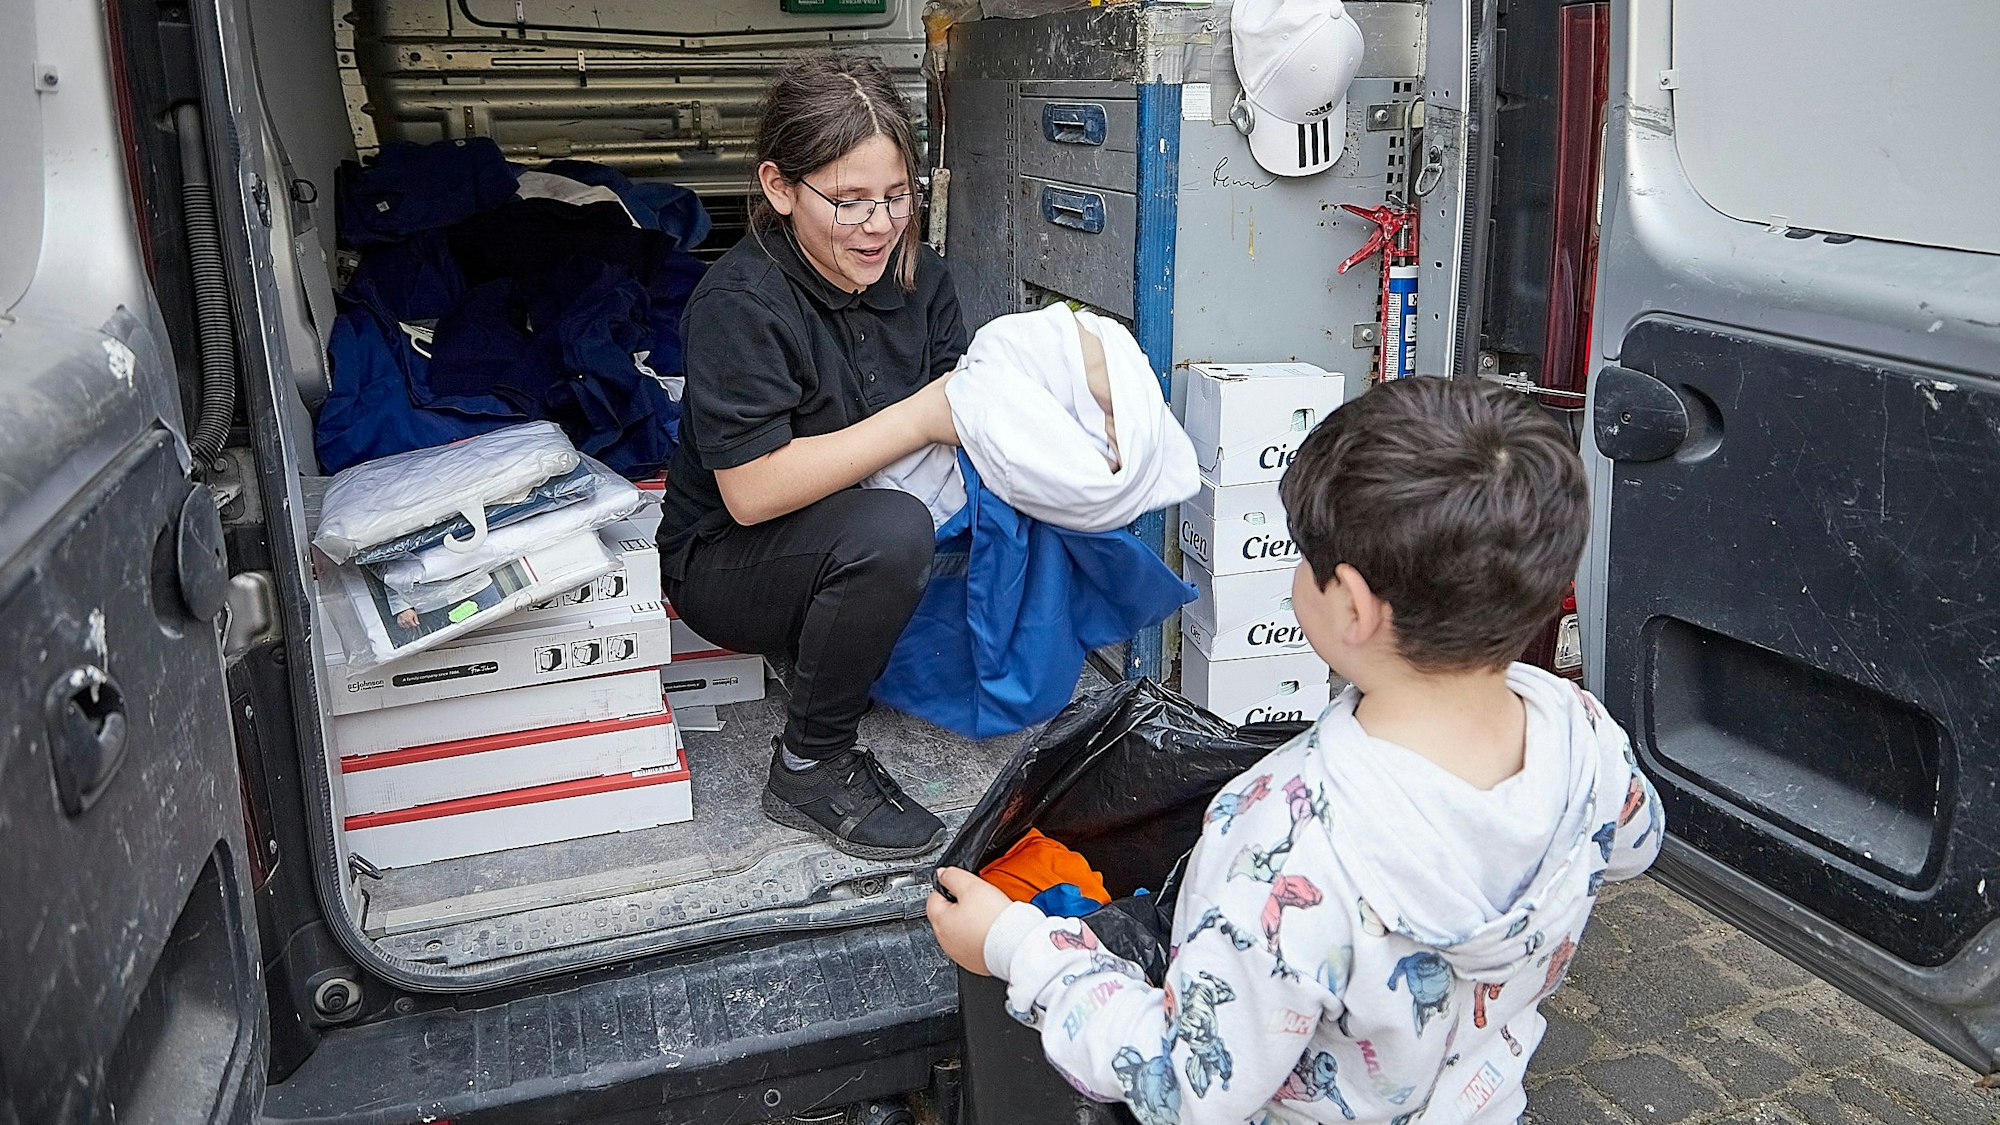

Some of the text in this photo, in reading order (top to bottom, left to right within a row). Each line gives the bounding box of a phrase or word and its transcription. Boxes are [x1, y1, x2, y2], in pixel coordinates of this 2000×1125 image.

[1258, 443, 1298, 469] Cie
[1182, 521, 1208, 554] Cien
[1241, 534, 1300, 560] Cien
[1189, 623, 1202, 641] Cien
[1247, 620, 1305, 646] Cien
